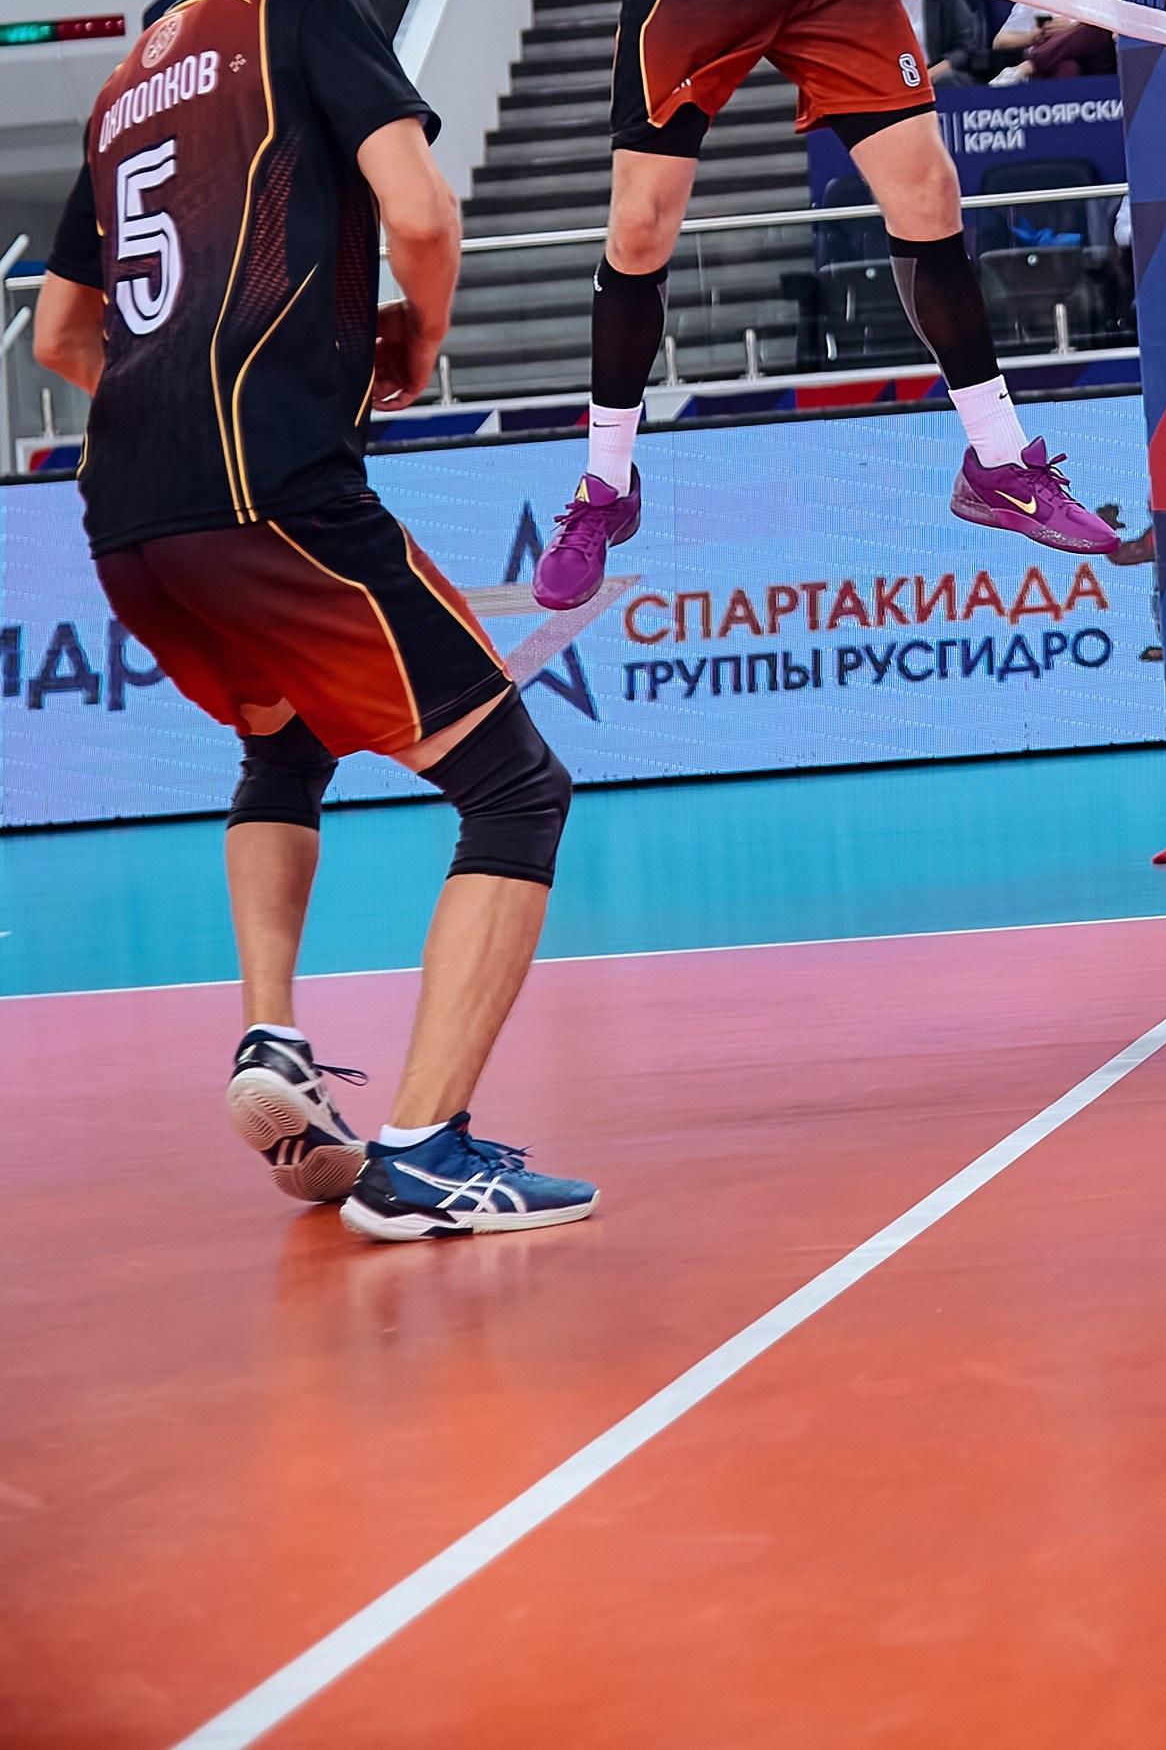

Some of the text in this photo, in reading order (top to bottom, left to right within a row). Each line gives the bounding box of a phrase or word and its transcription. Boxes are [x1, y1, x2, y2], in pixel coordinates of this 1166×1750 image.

[899, 53, 921, 87] 8
[964, 126, 1025, 153] КРАЙ
[115, 138, 181, 336] 5
[624, 561, 1110, 645] СПАРТАКИАДА
[623, 628, 1113, 701] ГРУППЫ РУСГИДРО
